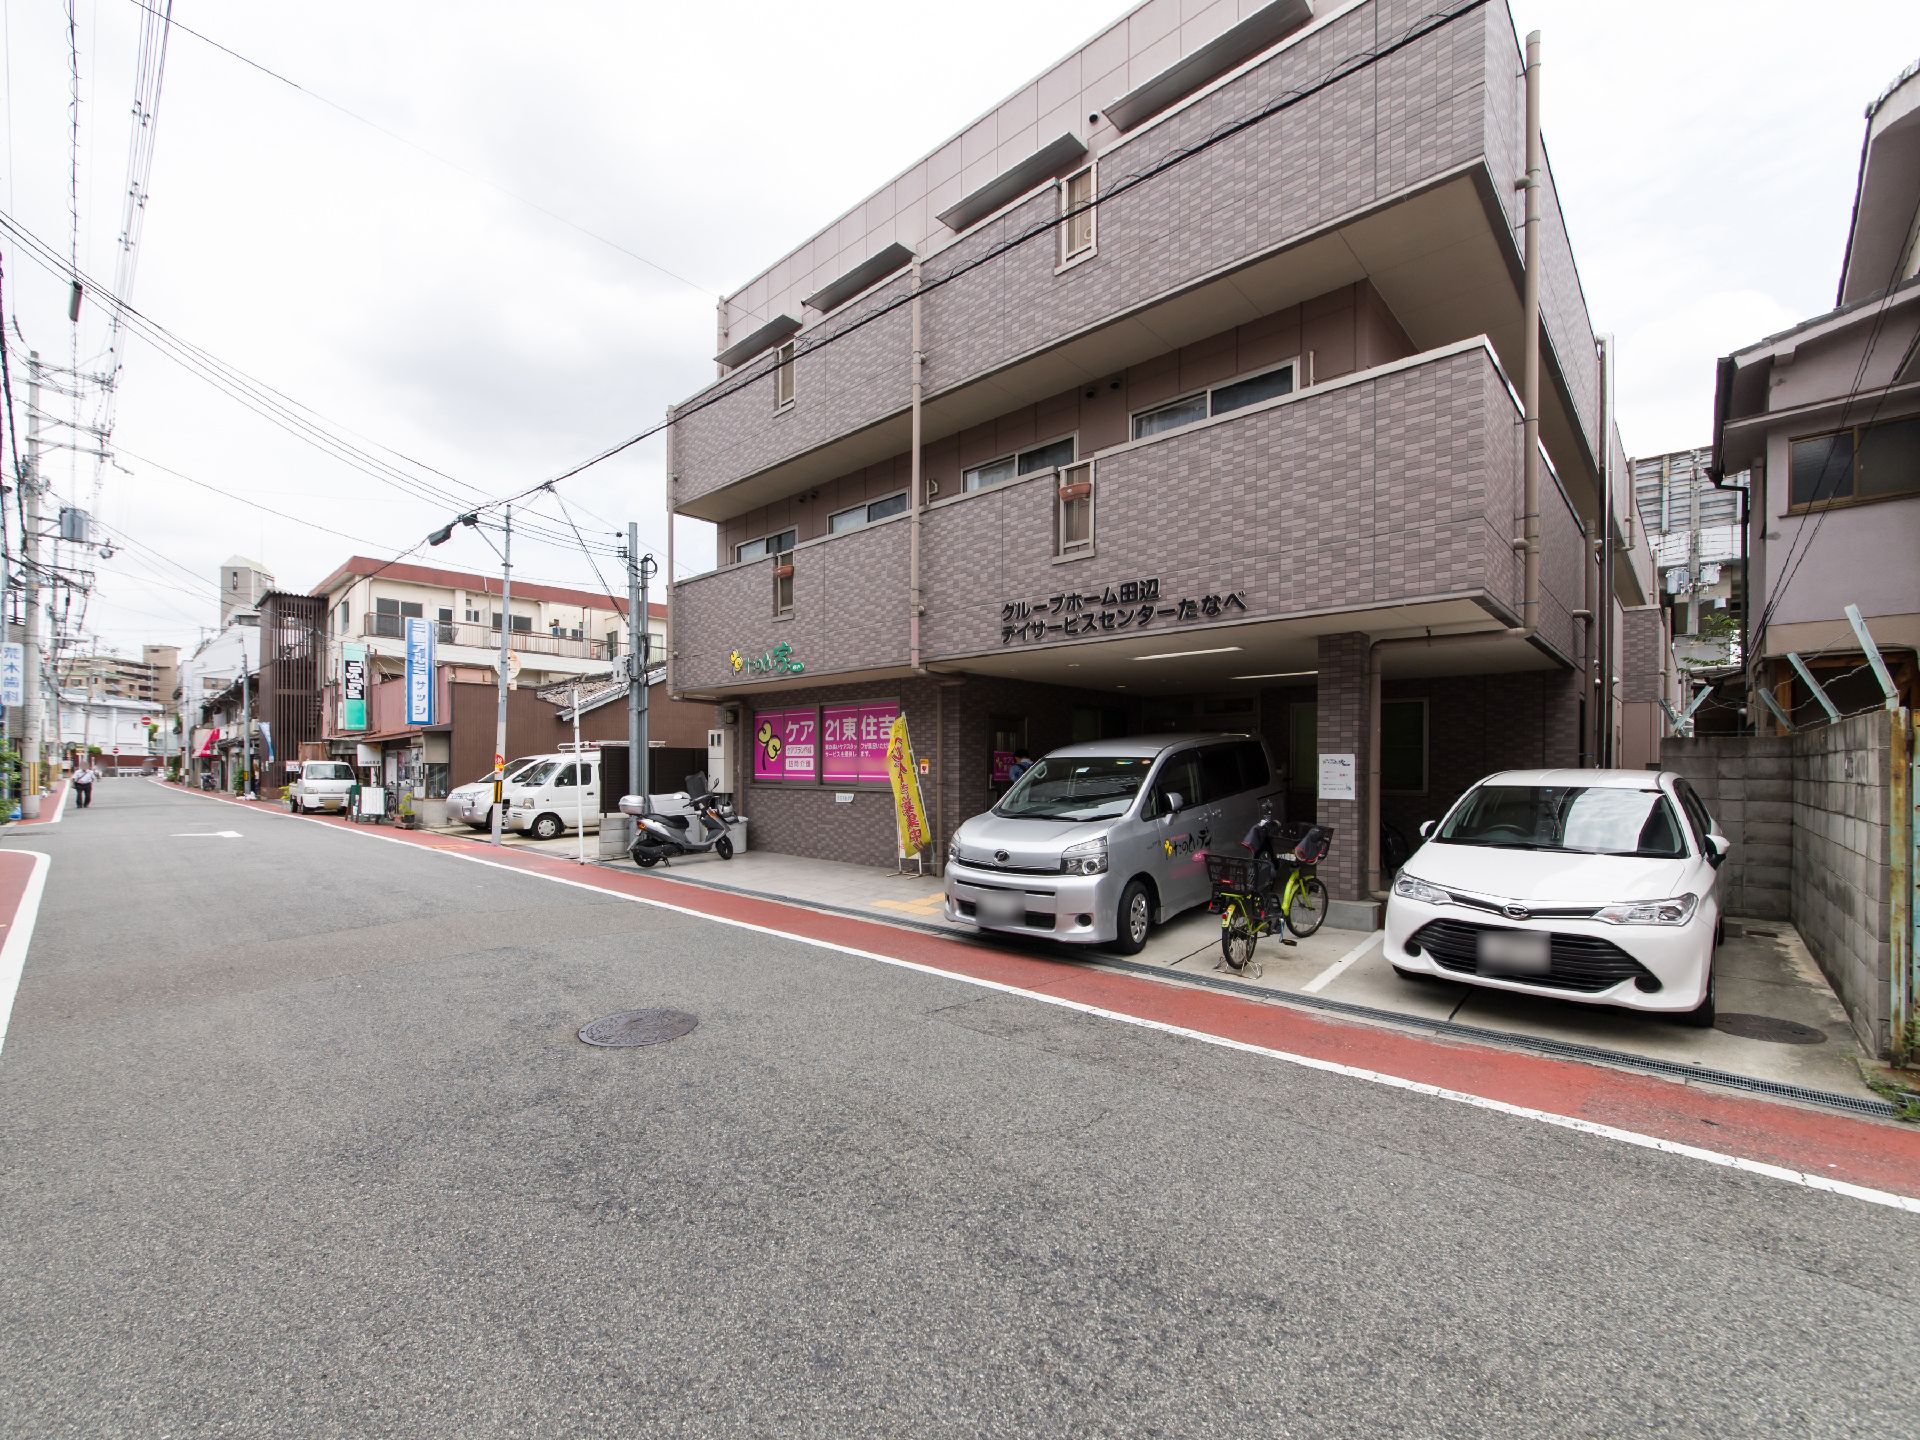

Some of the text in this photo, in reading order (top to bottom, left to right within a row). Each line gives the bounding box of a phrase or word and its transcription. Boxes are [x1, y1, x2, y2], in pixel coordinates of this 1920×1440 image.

[1001, 577, 1161, 621] グループホーム田辺
[1002, 590, 1247, 644] デイサービスセンターたなべ
